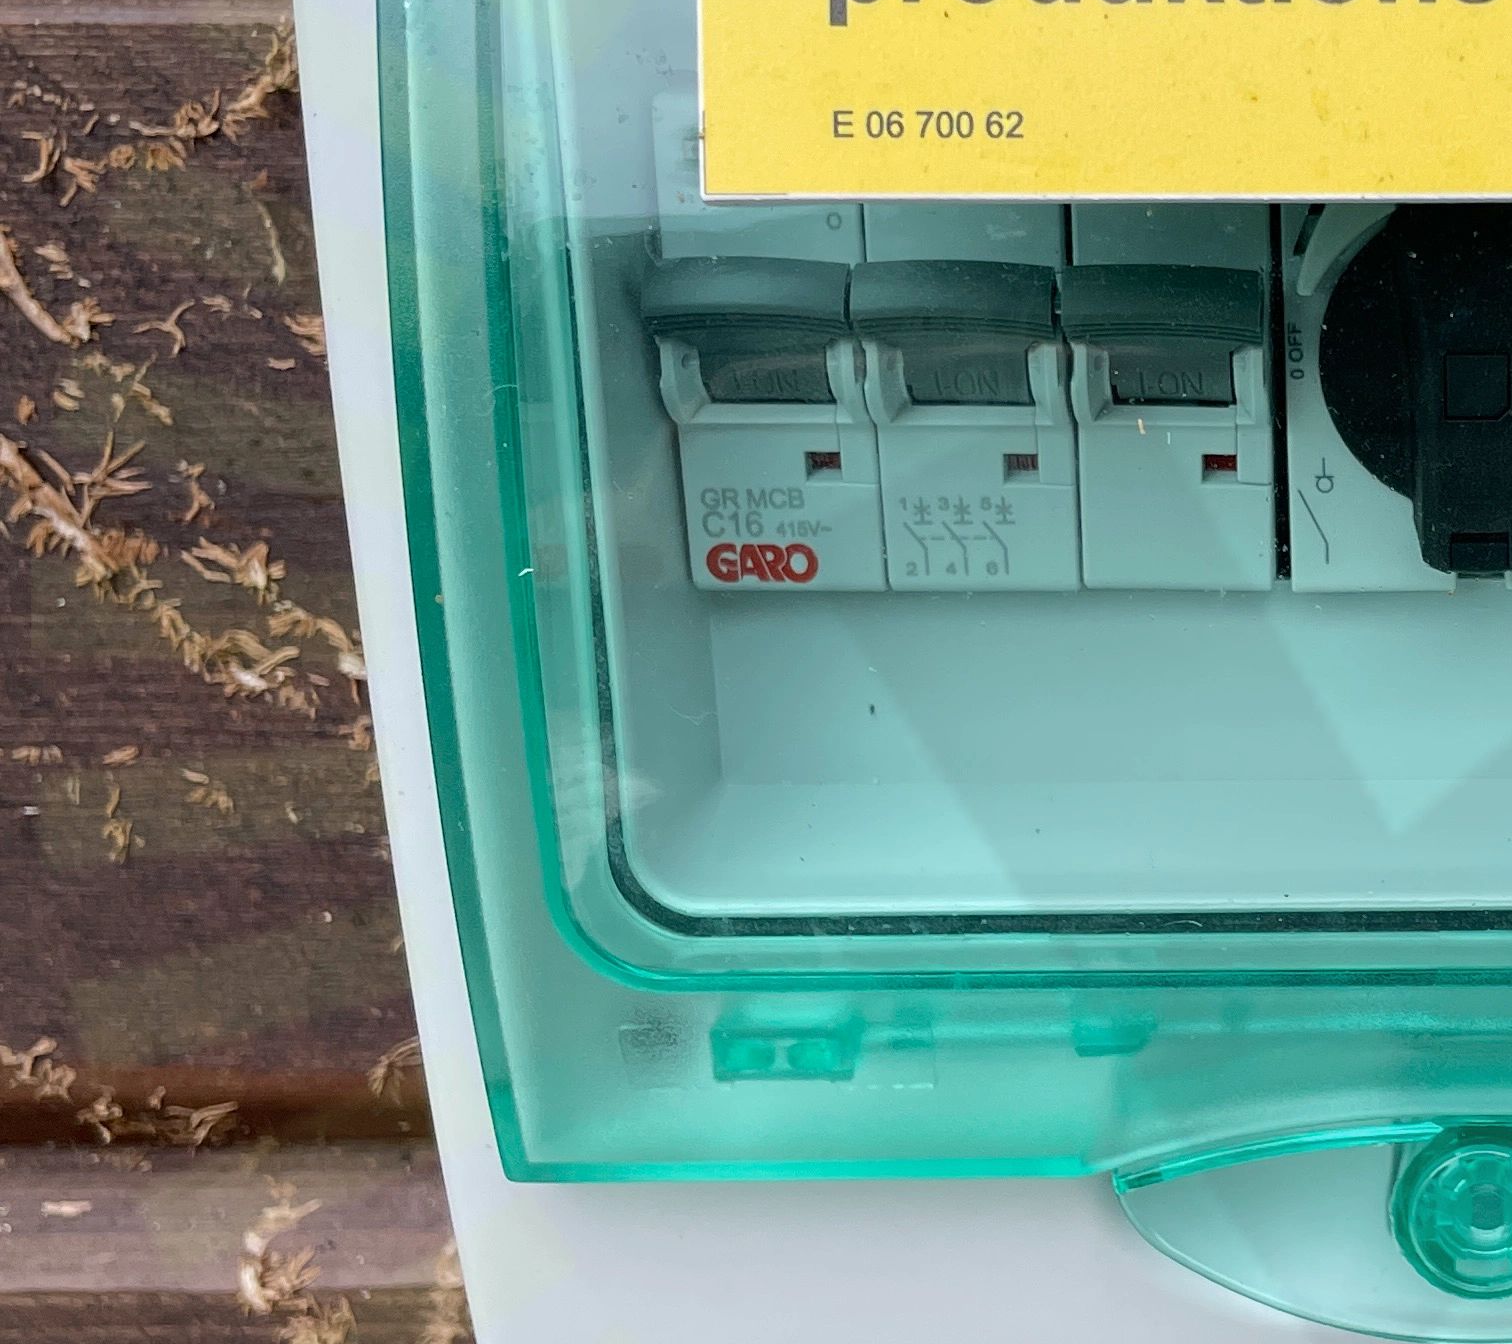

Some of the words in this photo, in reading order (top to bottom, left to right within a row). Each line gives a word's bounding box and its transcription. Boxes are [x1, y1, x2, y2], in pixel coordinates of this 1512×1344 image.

[832, 109, 854, 139] E
[866, 110, 905, 139] 06
[916, 110, 975, 139] 700
[985, 110, 1025, 139] 62
[1287, 321, 1304, 363] OFF
[700, 487, 741, 510] GR
[745, 487, 805, 510] MCB
[702, 510, 765, 538] C16
[706, 542, 819, 584] GARO
